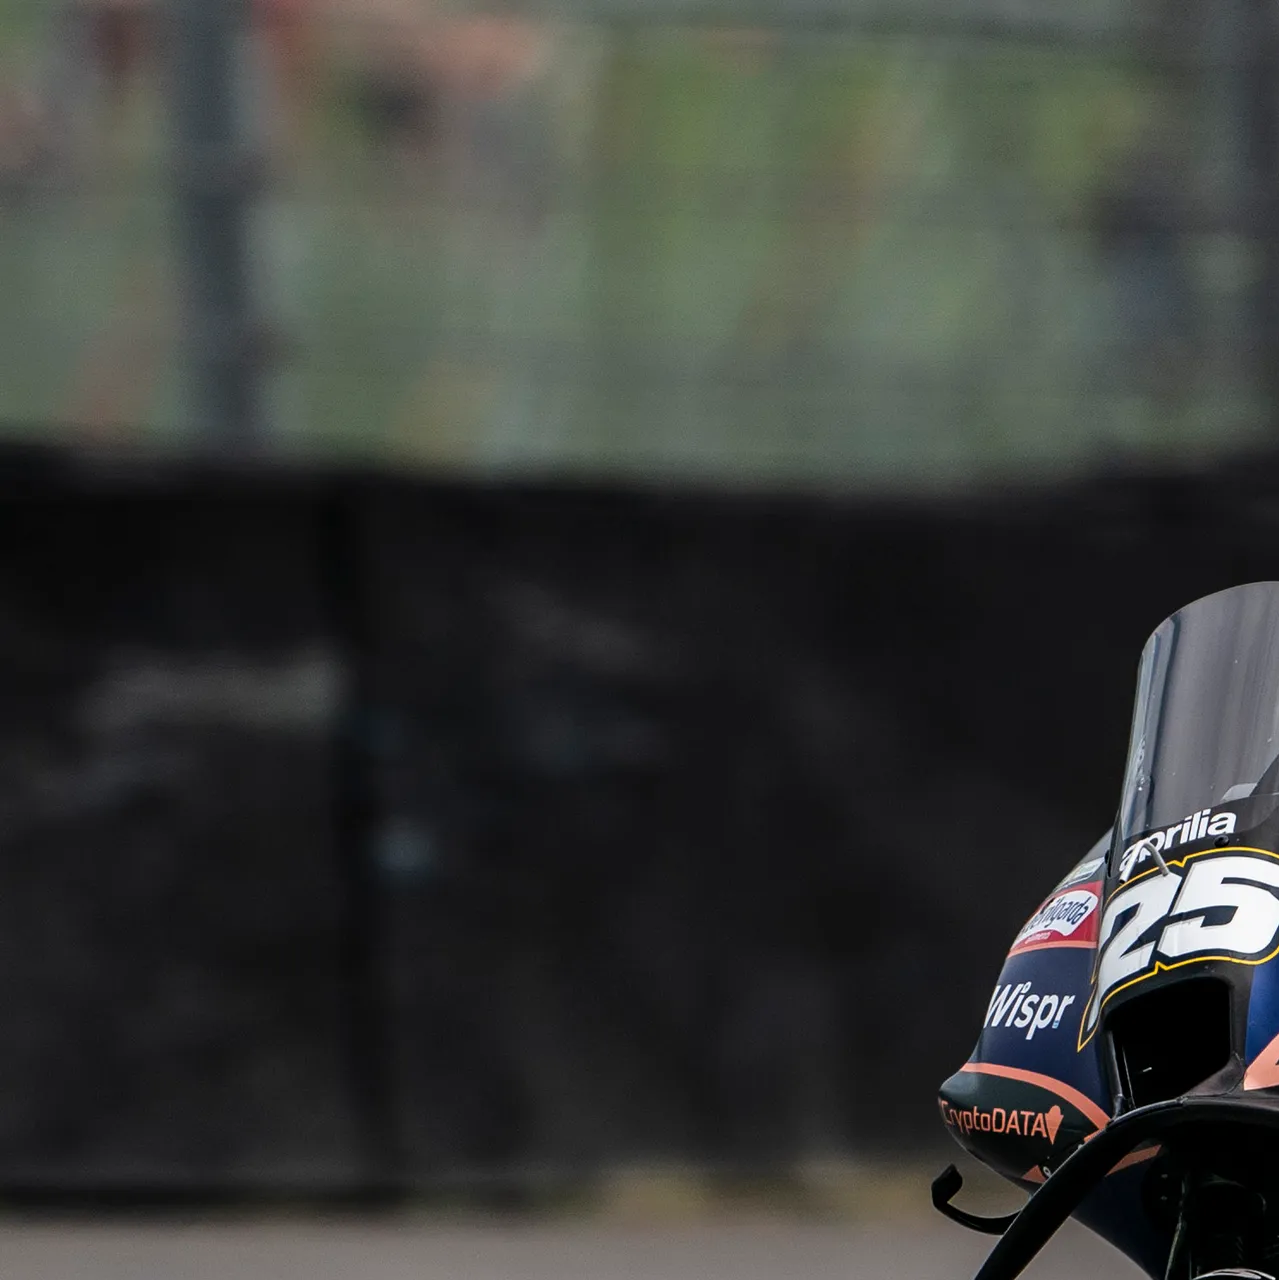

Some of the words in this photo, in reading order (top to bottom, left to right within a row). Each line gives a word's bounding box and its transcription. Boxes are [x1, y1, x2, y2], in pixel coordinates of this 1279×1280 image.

[1118, 808, 1238, 873] aprilia
[983, 981, 1076, 1041] Wispr
[940, 1098, 1050, 1138] CryptoDATA
